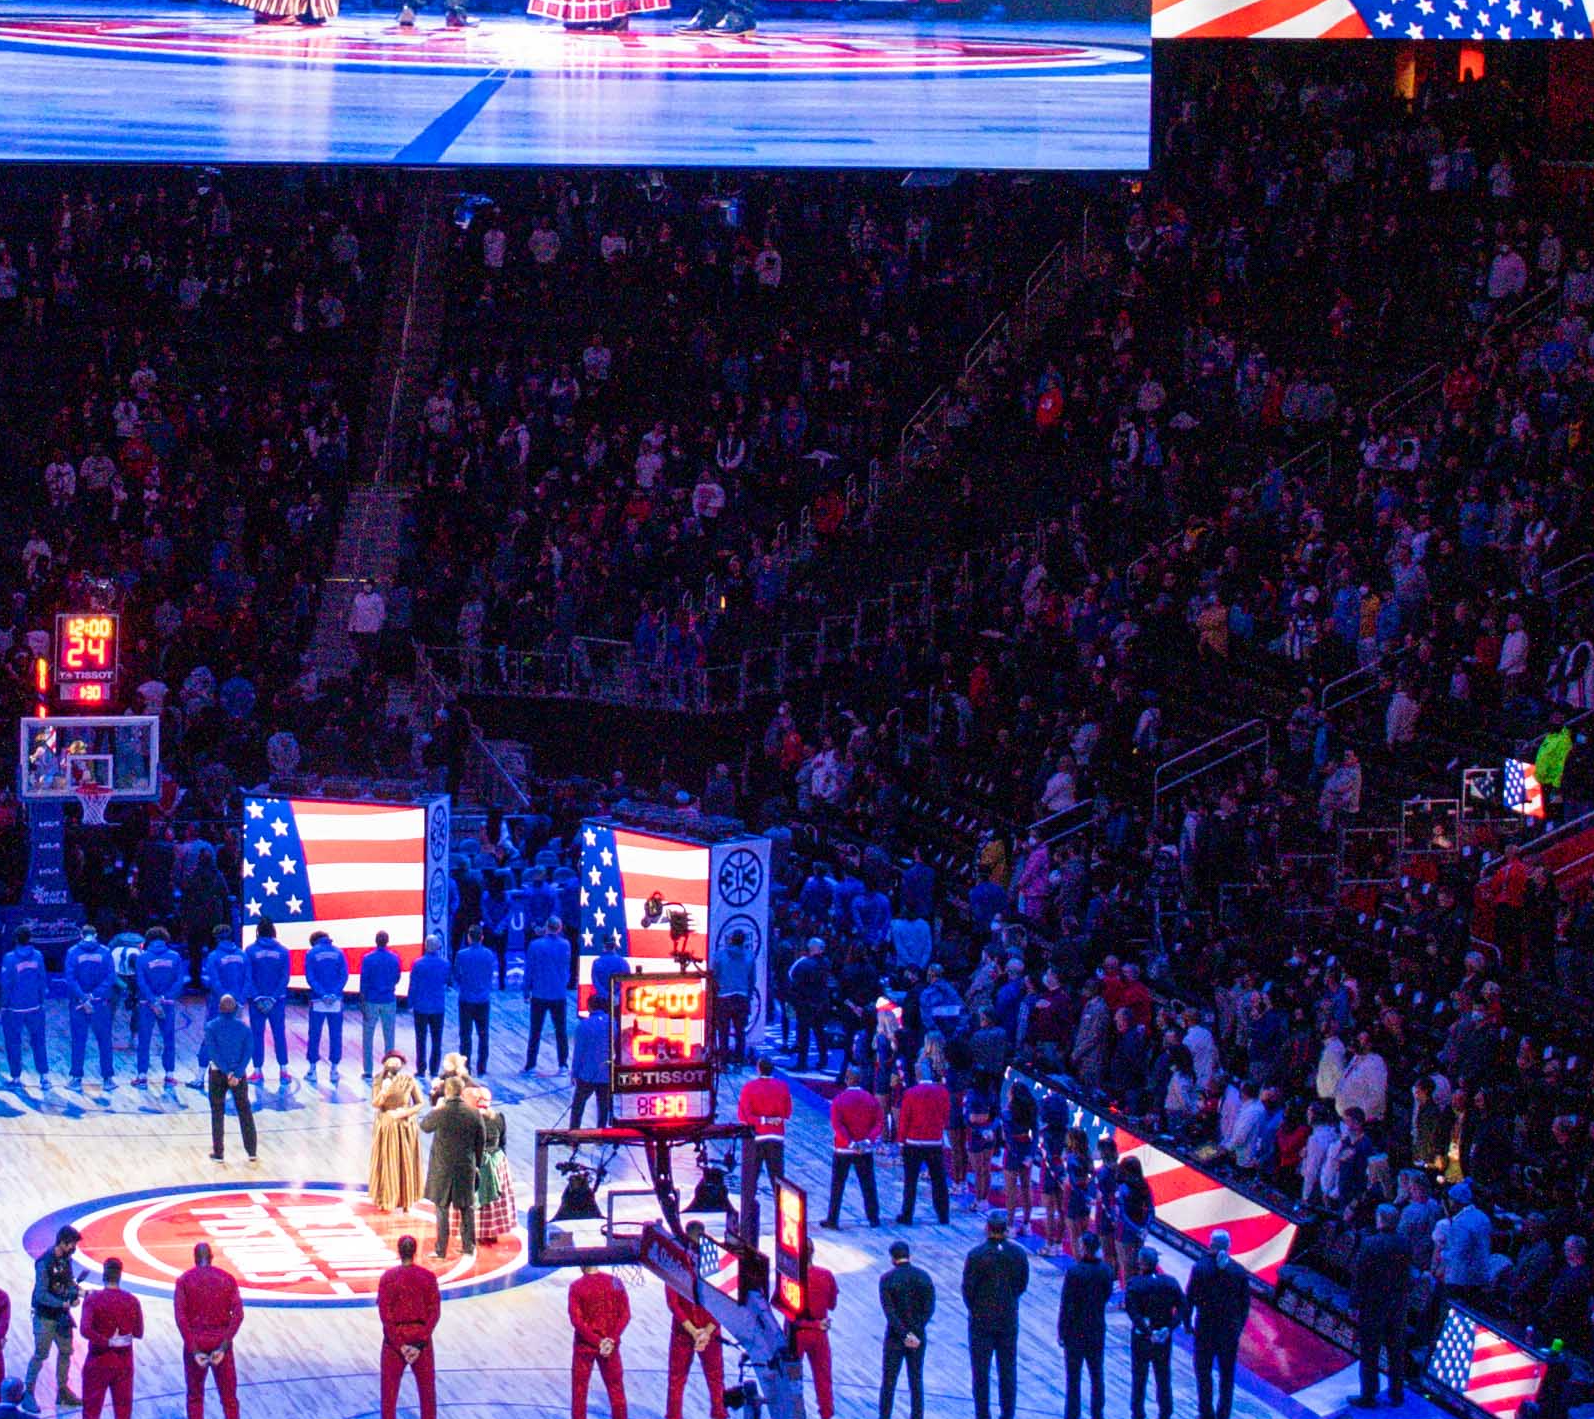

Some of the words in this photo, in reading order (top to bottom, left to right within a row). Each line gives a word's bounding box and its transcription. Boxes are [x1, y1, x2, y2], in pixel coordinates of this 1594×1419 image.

[68, 618, 111, 637] 12:00
[67, 637, 105, 667] 24
[75, 671, 114, 680] TISSOT
[633, 985, 701, 1014] 12:00
[632, 1015, 693, 1062] 24
[644, 1070, 707, 1085] TISSOT
